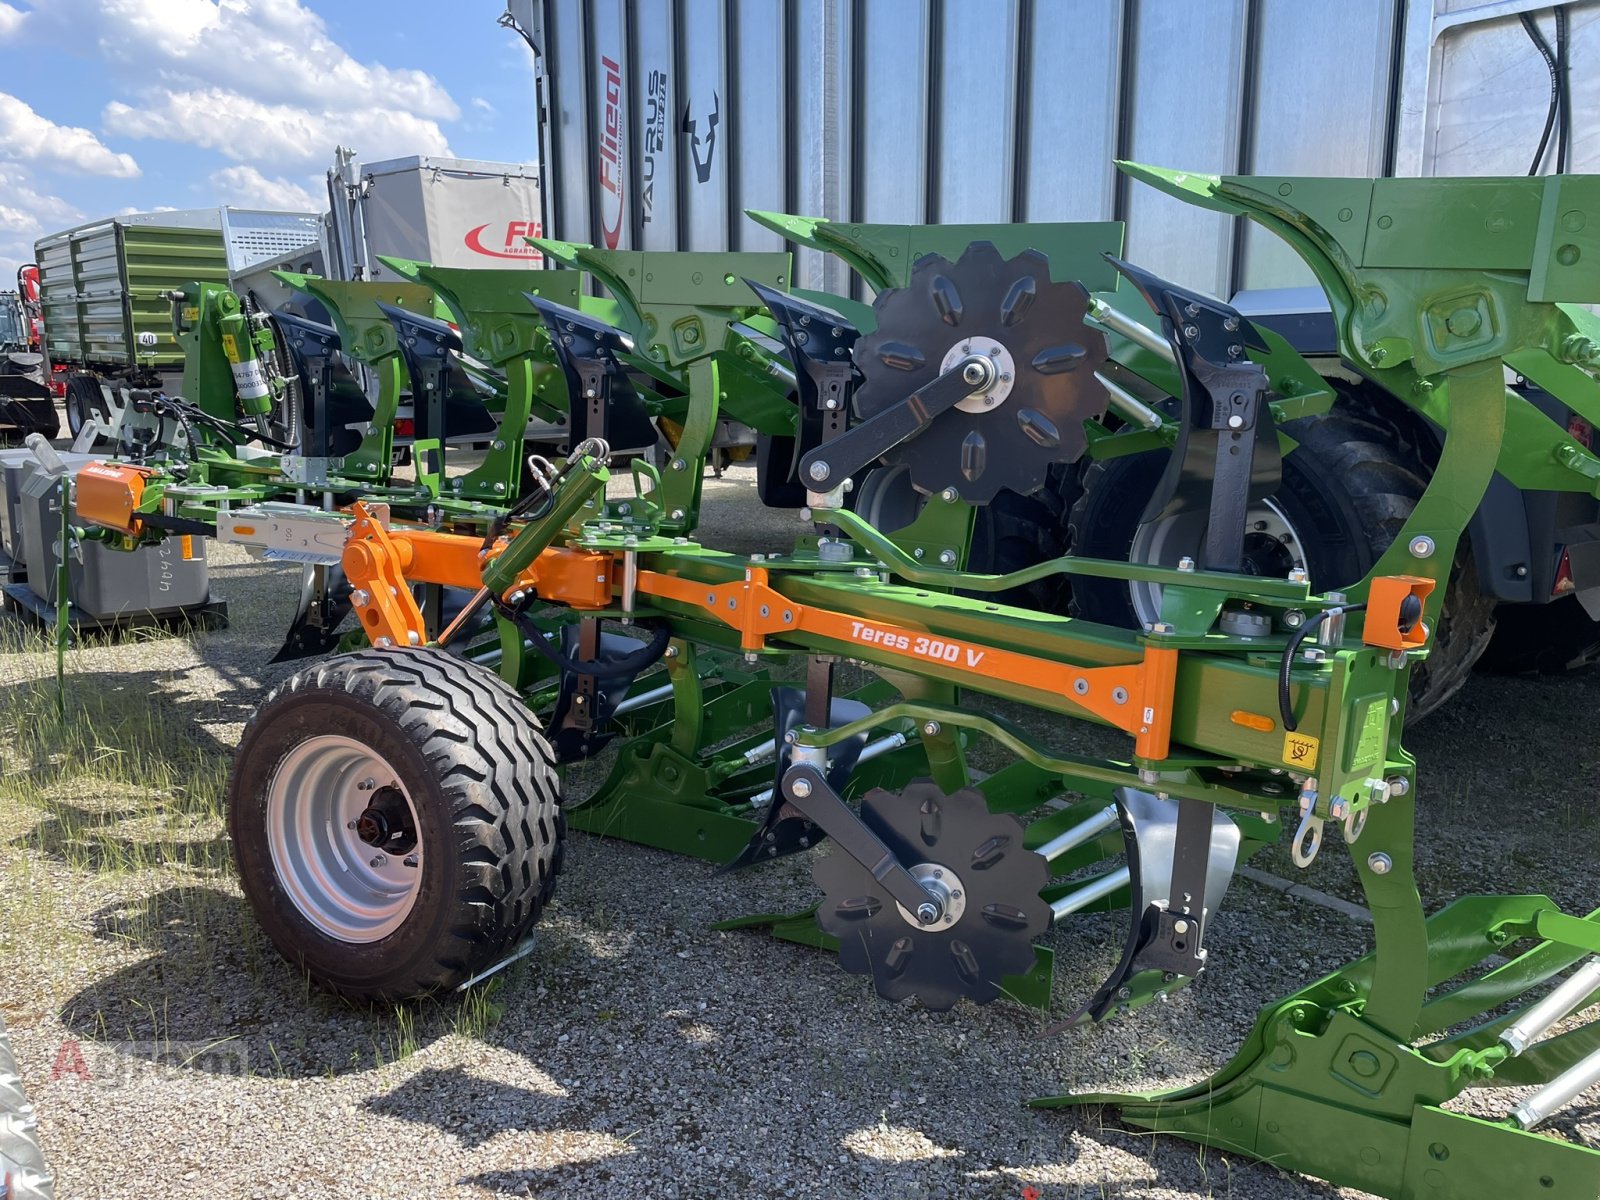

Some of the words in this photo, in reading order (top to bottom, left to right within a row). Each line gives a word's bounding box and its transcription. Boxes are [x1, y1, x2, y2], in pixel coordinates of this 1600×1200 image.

[599, 56, 621, 194] Fliegl
[642, 69, 659, 229] TAURUS
[142, 334, 153, 345] 40
[851, 622, 910, 650] Teres
[913, 636, 960, 662] 300
[966, 648, 985, 667] V
